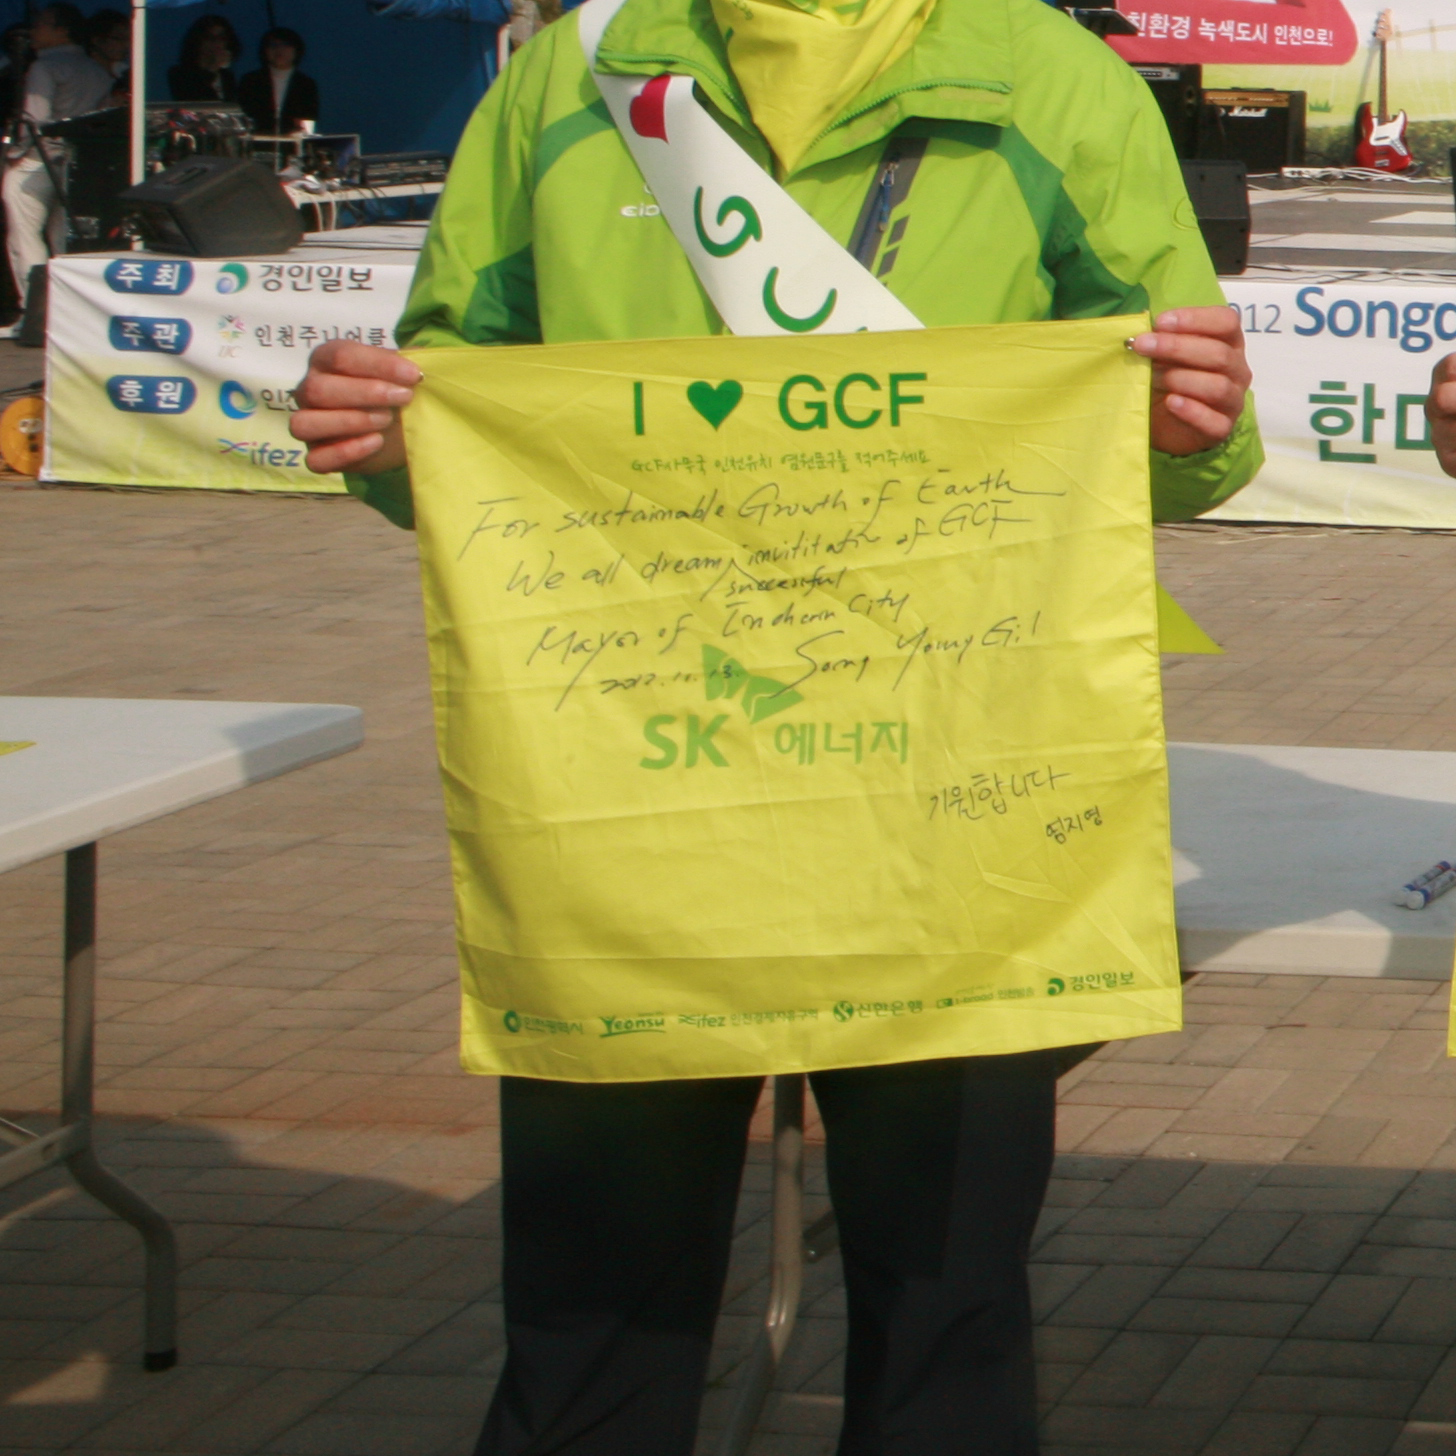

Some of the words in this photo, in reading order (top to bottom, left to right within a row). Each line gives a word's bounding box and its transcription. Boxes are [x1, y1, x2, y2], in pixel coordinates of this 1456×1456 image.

[1198, 18, 1268, 44] 녹색도시
[1274, 25, 1334, 46] 인천으로!
[258, 265, 374, 292] 경인일보
[633, 381, 644, 436] I
[777, 372, 929, 432] GCF
[252, 442, 302, 467] ifez
[631, 454, 707, 475] GCF사무국
[714, 453, 773, 471] 인천유치
[780, 451, 849, 473] 염원문구를
[855, 449, 931, 467] 적어주세요
[457, 497, 540, 561] For
[555, 488, 724, 533] sustainable
[738, 483, 847, 527] Growth
[863, 480, 900, 537] of
[917, 469, 1067, 504] Earth
[506, 550, 564, 597] We
[582, 553, 624, 586] all
[641, 551, 721, 579] dream
[896, 517, 931, 555] of
[938, 498, 1034, 539] GCF
[526, 626, 641, 711] Mayor
[658, 614, 694, 654] of
[848, 592, 909, 621] City
[768, 630, 870, 699] Song
[639, 714, 731, 770] SK
[774, 721, 910, 765] 에너지
[928, 765, 1072, 821] 기원합니다
[600, 1016, 665, 1035] Yeonsu
[695, 1014, 726, 1028] ifez
[857, 1000, 923, 1018] 신한은행
[1069, 971, 1135, 991] 경인일보
